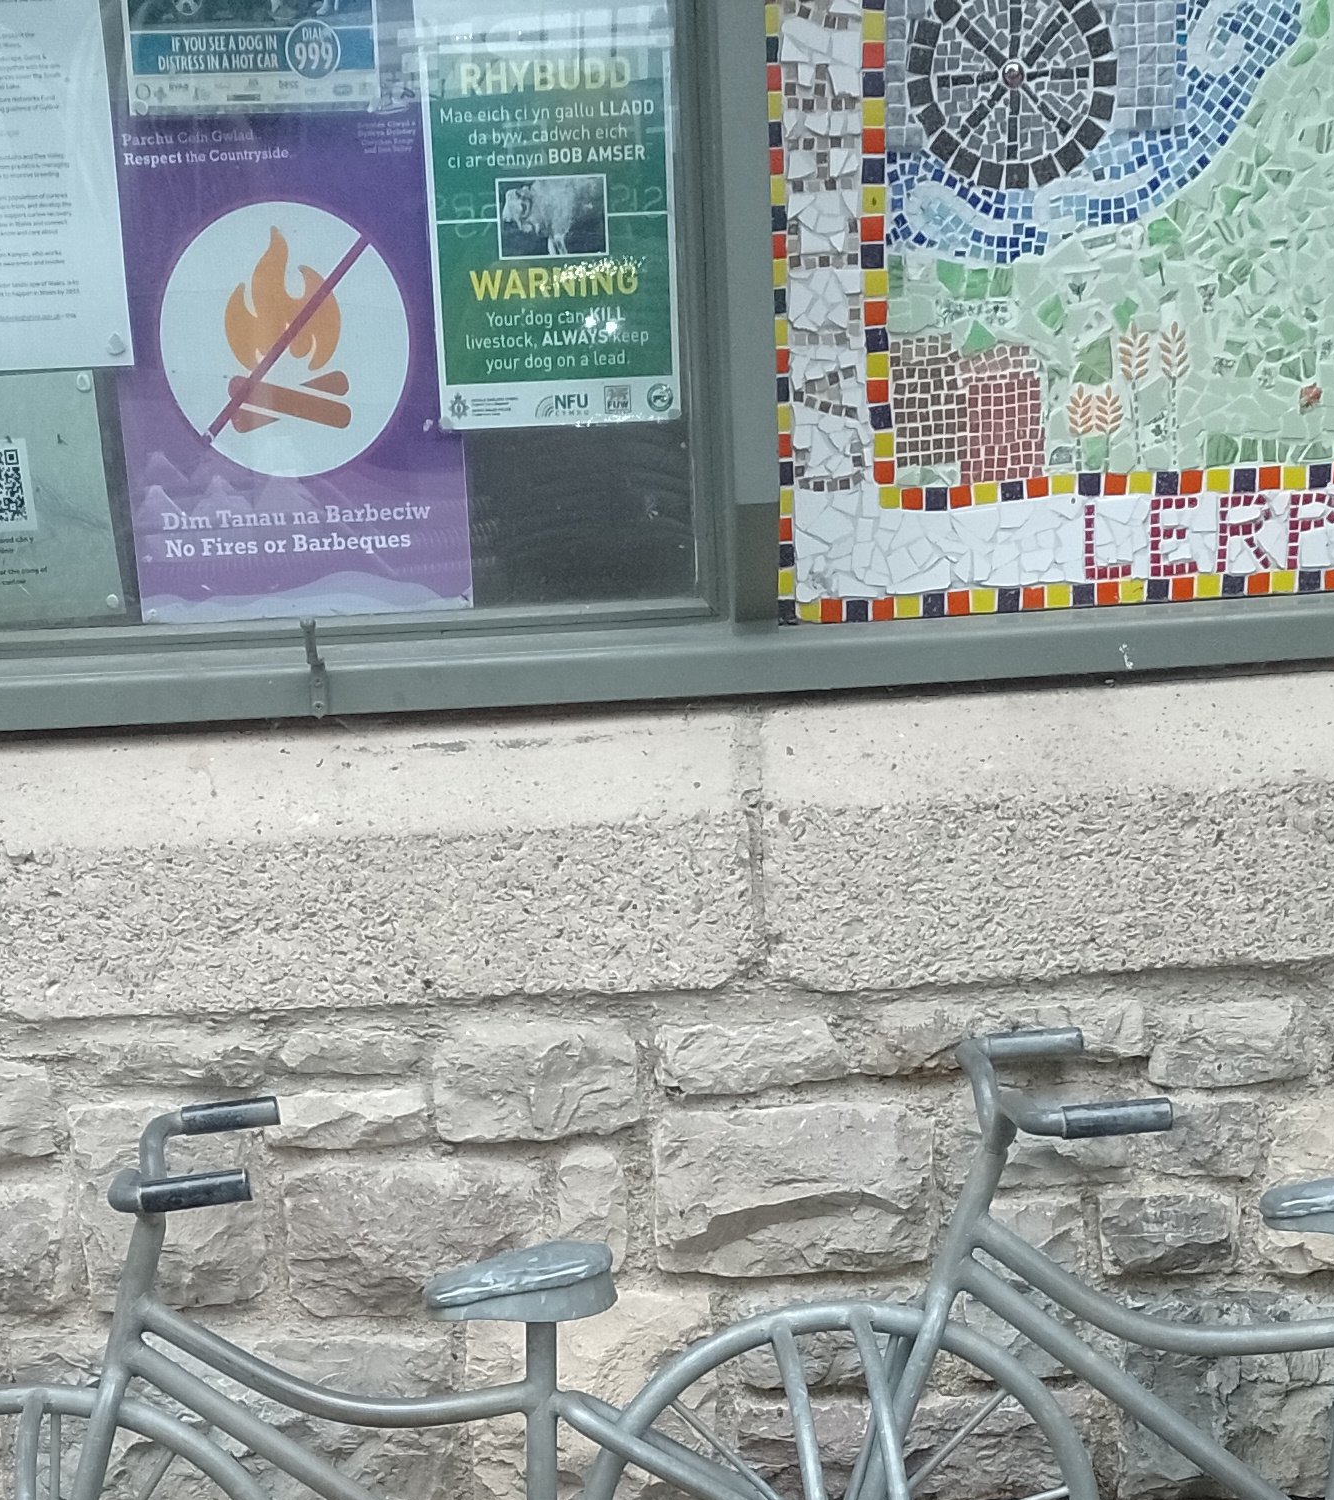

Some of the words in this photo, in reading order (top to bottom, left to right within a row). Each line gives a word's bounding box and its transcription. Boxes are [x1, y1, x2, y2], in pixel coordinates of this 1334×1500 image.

[171, 36, 183, 52] IF
[183, 36, 207, 52] YOU
[209, 36, 227, 51] SEE
[228, 36, 237, 50] A
[239, 36, 262, 50] DOG
[265, 34, 277, 50] IN
[158, 54, 205, 72] DISTRESS
[207, 54, 218, 70] IN
[220, 54, 229, 70] A
[231, 54, 255, 70] HOT
[257, 53, 279, 68] CAR
[295, 42, 333, 70] 999
[460, 56, 631, 96] RHYBUDD
[440, 107, 473, 124] Mae
[477, 106, 510, 122] eich
[515, 105, 527, 122] ci
[531, 106, 549, 122] yn
[555, 103, 595, 121] gallu
[599, 100, 655, 116] LLADD
[121, 132, 173, 147] Parchu
[469, 129, 487, 146] da
[531, 126, 591, 144] cadwch
[595, 124, 628, 140] eich
[123, 152, 182, 168] Respect
[185, 150, 206, 162] the
[447, 154, 461, 169] ci
[487, 150, 544, 170] dennyn
[548, 148, 583, 164] BOB
[469, 262, 640, 301] WARNING
[486, 311, 521, 328] Your
[525, 310, 553, 328] dog
[557, 311, 585, 325] can
[589, 306, 627, 323] KILL
[466, 334, 538, 350] livestock,
[541, 329, 609, 346] ALWAYS
[613, 329, 649, 346] keep
[485, 356, 521, 375] your
[525, 353, 552, 372] dog
[593, 350, 630, 366] lead.
[554, 393, 589, 409] NFU
[161, 511, 212, 530] Dim
[216, 510, 287, 528] Tanau
[293, 510, 319, 524] na
[325, 502, 431, 524] Barbeciw
[165, 539, 195, 558] No
[201, 537, 259, 556] Fires
[292, 532, 411, 554] Barbeques
